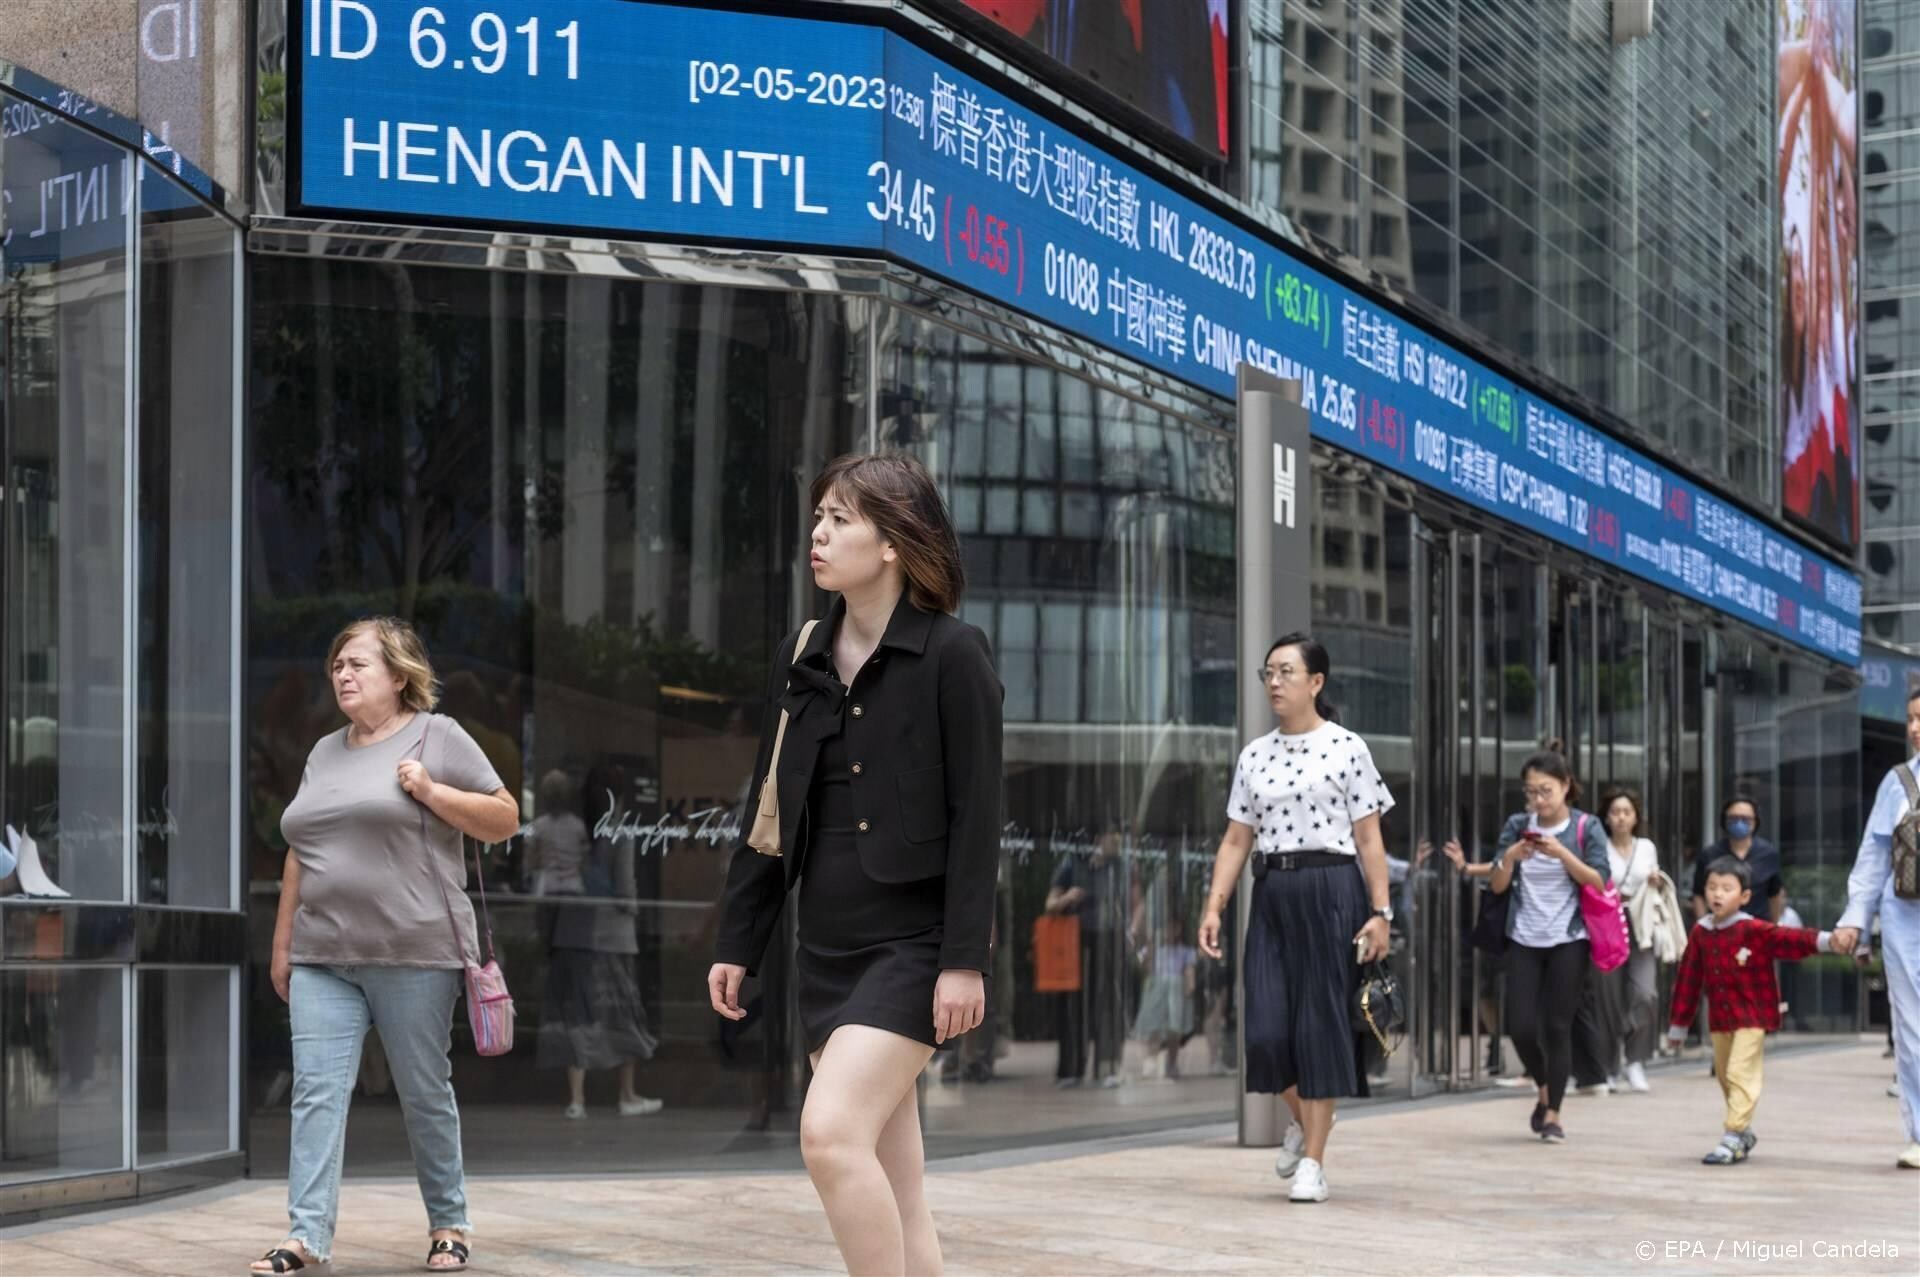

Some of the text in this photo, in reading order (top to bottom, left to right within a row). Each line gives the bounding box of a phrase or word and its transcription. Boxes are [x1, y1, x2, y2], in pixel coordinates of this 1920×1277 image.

[310, 0, 579, 79] ID 6.911
[343, 118, 645, 197] HENGAN
[672, 146, 828, 214] INT'L
[866, 160, 936, 242] 34.45
[1044, 242, 1099, 315] 01088
[1106, 266, 1186, 364] 中國神華
[1192, 317, 1241, 376] CHINA
[1322, 374, 1356, 430] 25.85
[930, 72, 1141, 251] 標普香港大型股指數
[1150, 202, 1184, 263] HKL
[1188, 221, 1255, 300] 28333.73
[1404, 339, 1424, 387] HSI
